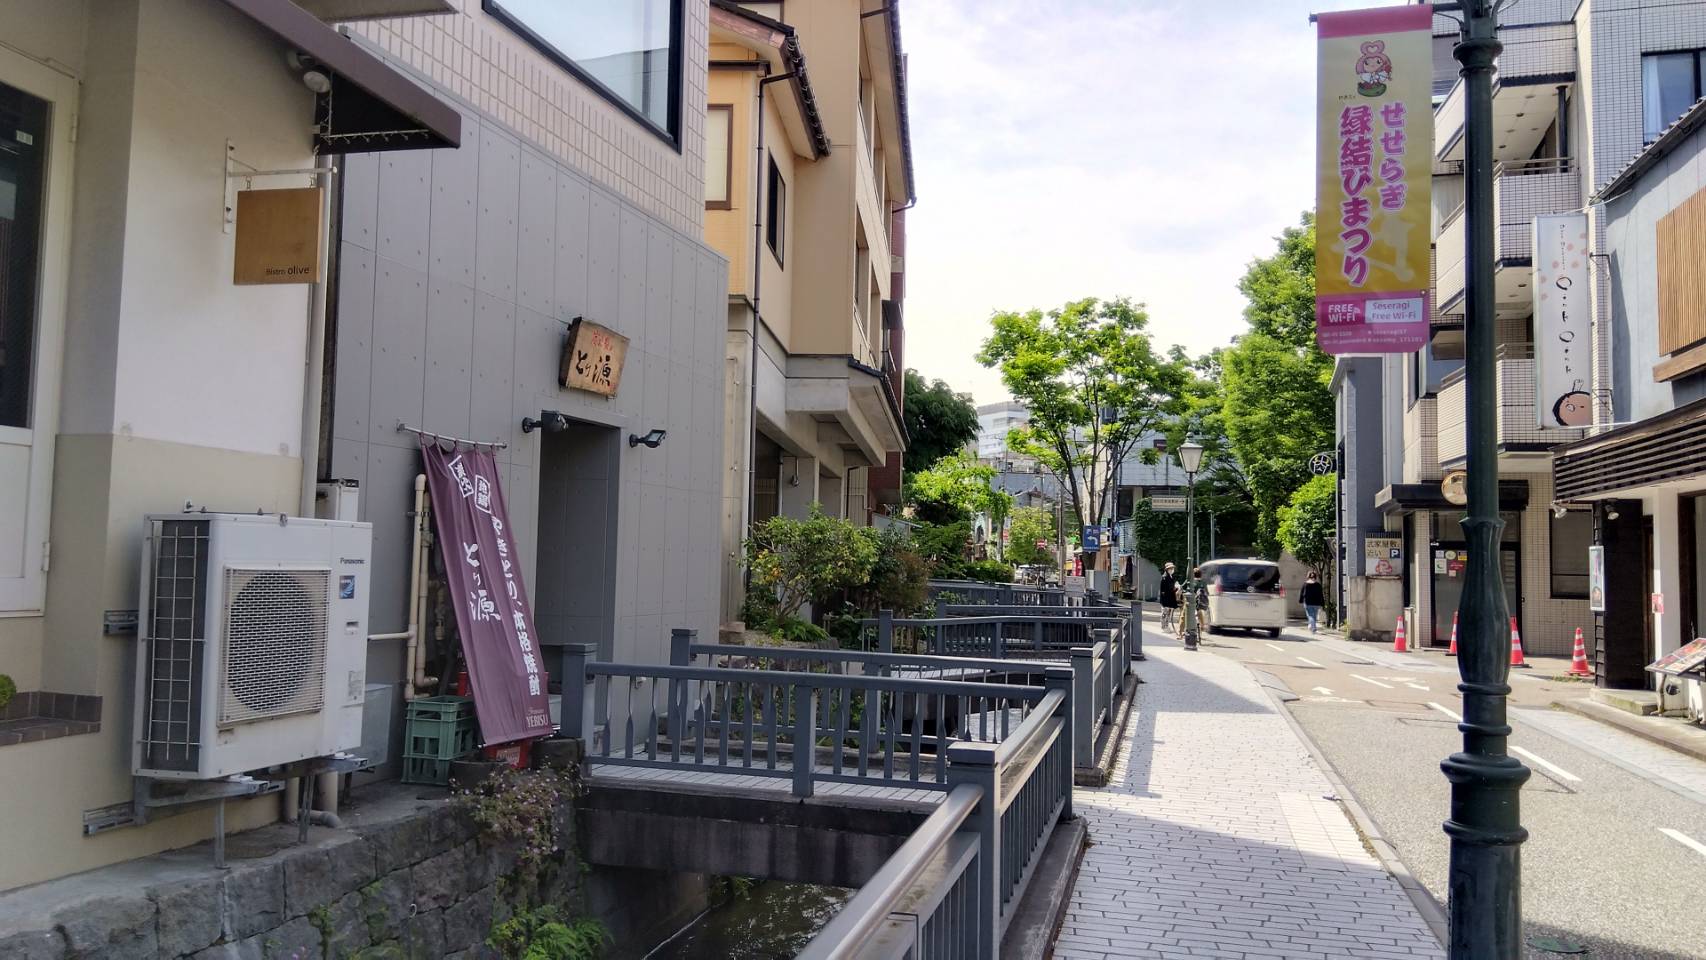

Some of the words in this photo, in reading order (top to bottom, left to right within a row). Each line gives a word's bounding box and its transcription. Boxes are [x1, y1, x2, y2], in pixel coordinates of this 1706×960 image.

[1380, 102, 1405, 209] せせらぎ
[1340, 105, 1373, 285] 縁結びまつり
[288, 265, 310, 275] olive
[1328, 304, 1353, 313] FREE
[1372, 301, 1410, 310] Seseragi
[1372, 312, 1391, 320] Free
[1393, 311, 1416, 320] Wi-Fi
[526, 713, 549, 728] YEBISU
